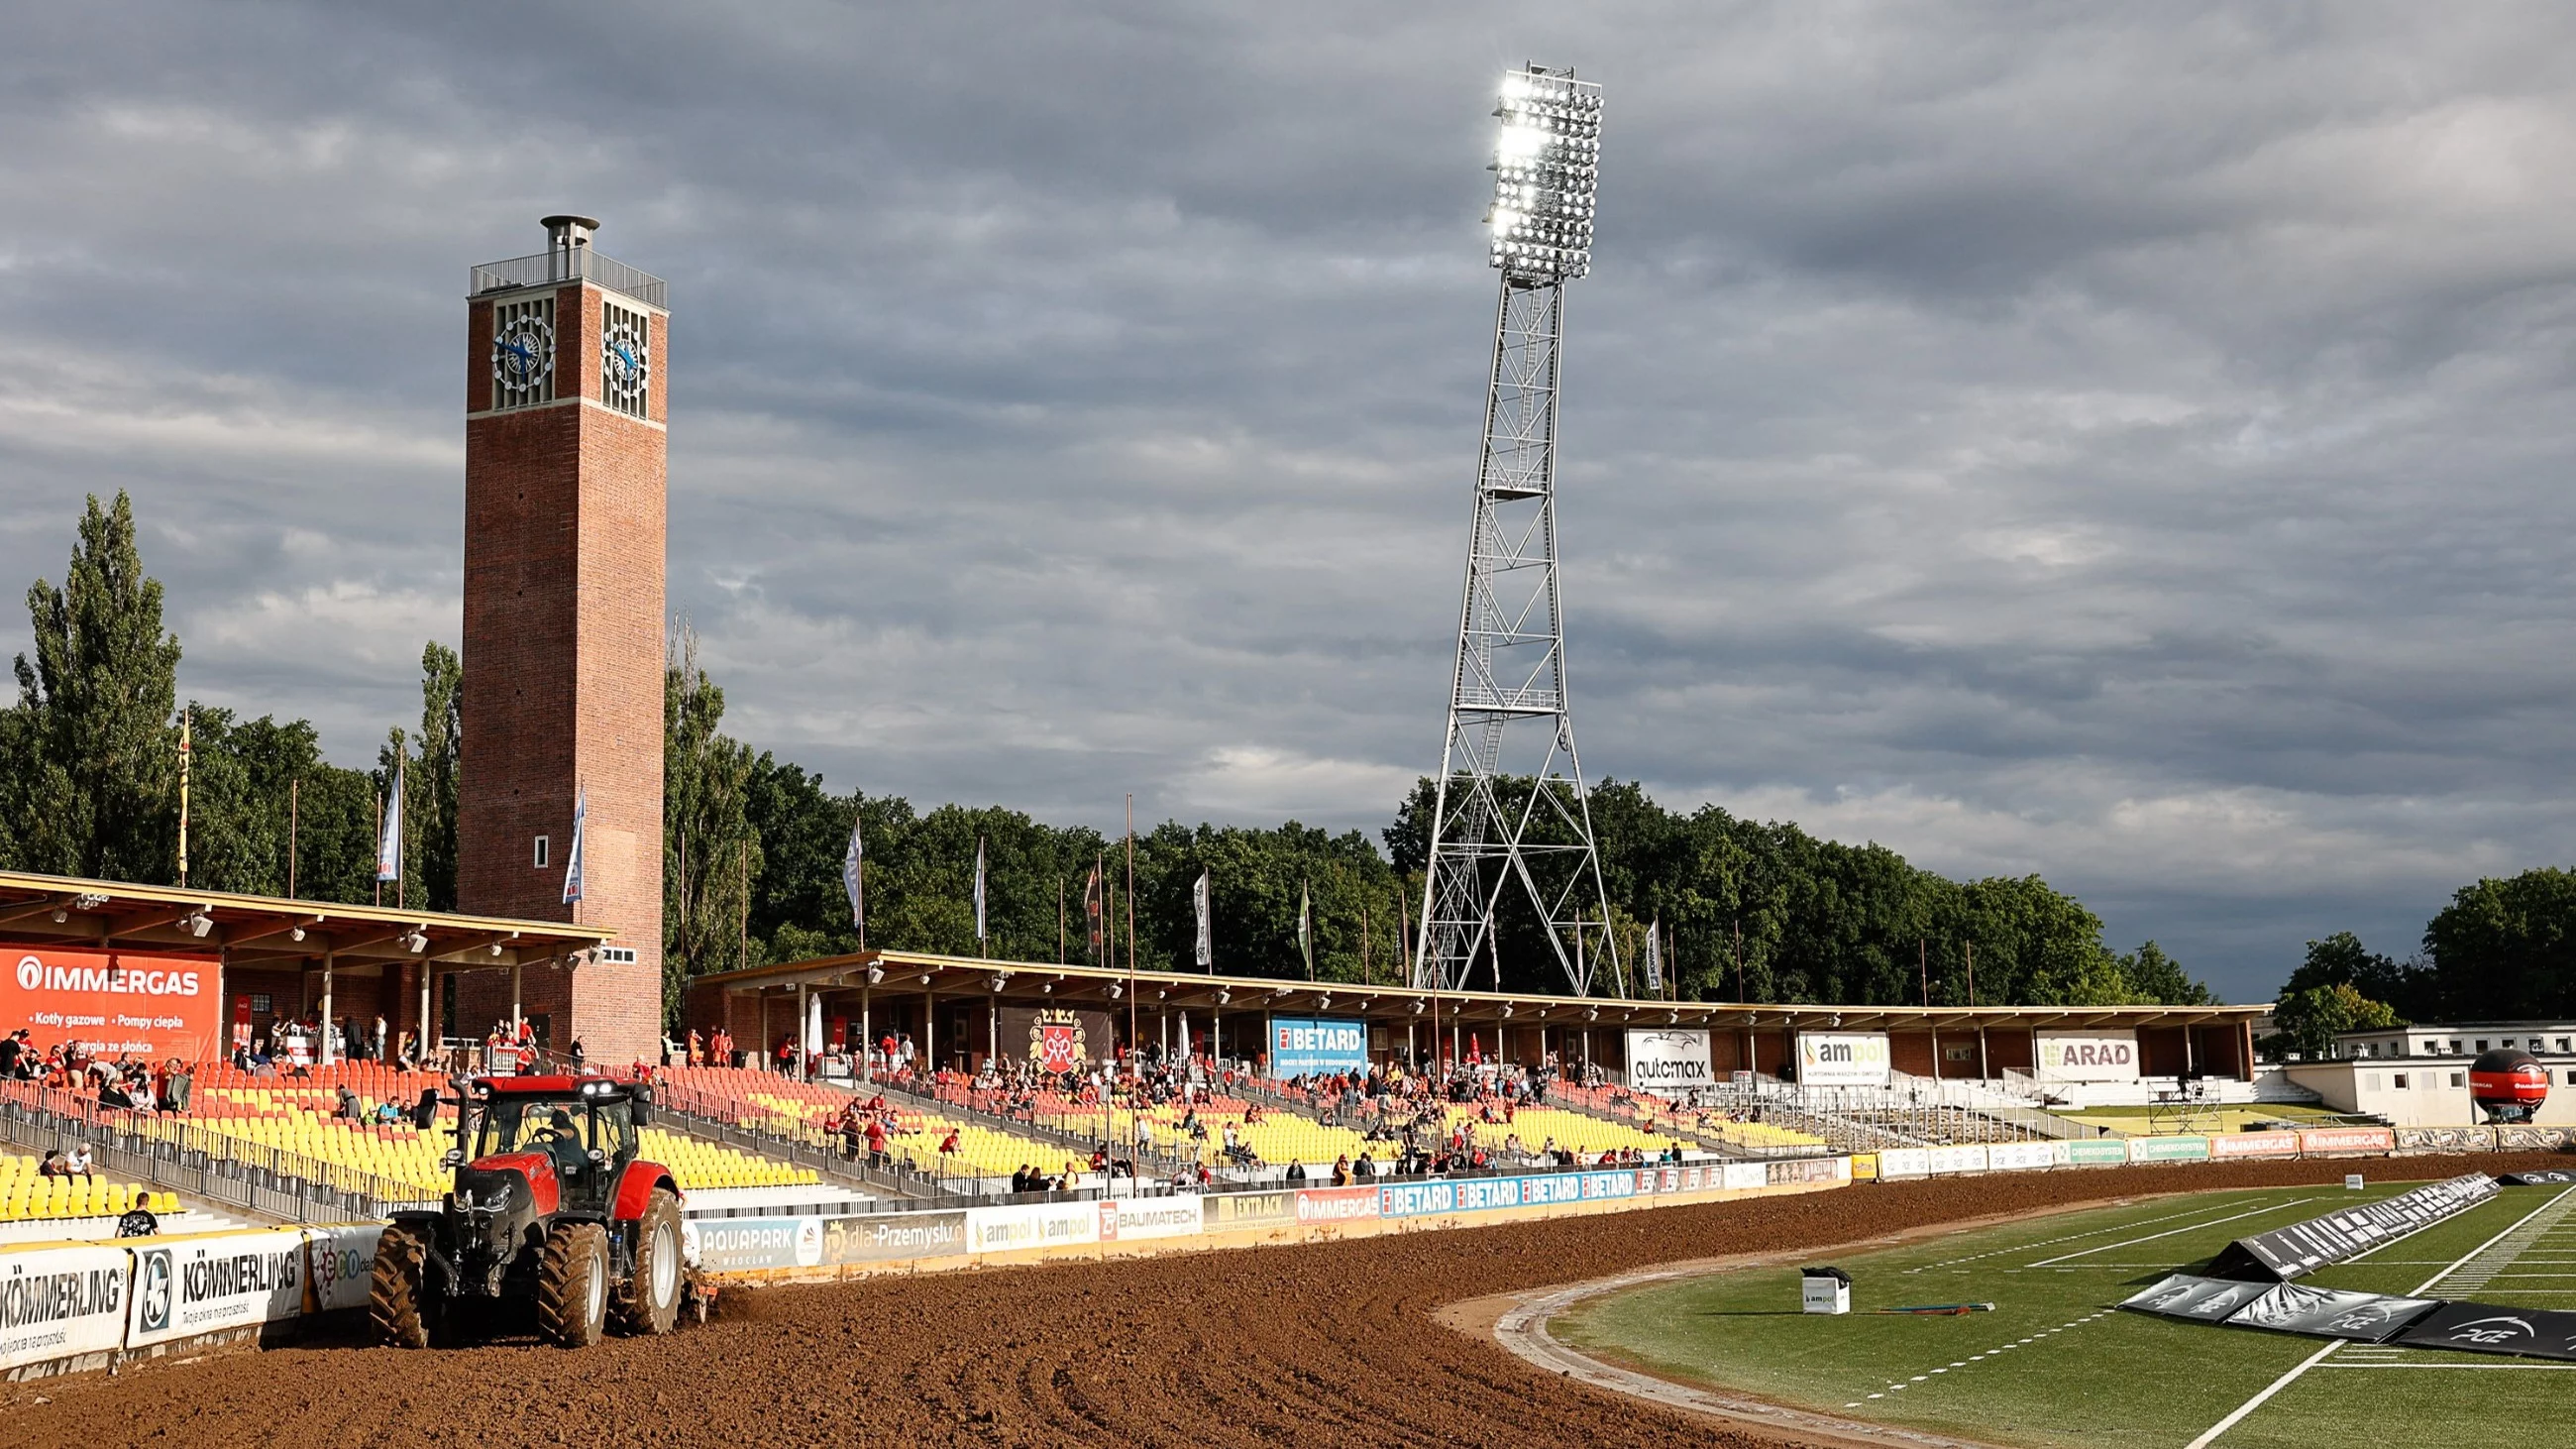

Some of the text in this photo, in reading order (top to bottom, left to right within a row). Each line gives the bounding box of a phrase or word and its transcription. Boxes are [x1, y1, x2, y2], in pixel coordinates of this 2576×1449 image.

[44, 965, 199, 996] IMMERGAS
[35, 1012, 63, 1027] Kotły
[65, 1016, 105, 1027] gazowe
[117, 1014, 153, 1030] Pompy
[107, 1043, 120, 1053] ze
[1293, 1027, 1360, 1051] BETARD
[1819, 1040, 1884, 1068] ampol
[2063, 1044, 2131, 1066] ARAD
[1636, 1057, 1706, 1079] automax
[2228, 1135, 2295, 1153] IMMERGAS
[2316, 1133, 2387, 1148] IMMERGAS
[1466, 1180, 1519, 1208] BETARD
[1531, 1175, 1579, 1202] BETARD
[1590, 1171, 1634, 1198] BETARD
[1238, 1194, 1283, 1218] ENTRACK
[1309, 1196, 1380, 1220] IMMERGAS
[1394, 1185, 1452, 1214] BETARD
[986, 1216, 1032, 1244] ampol
[1047, 1212, 1091, 1241] ampol
[1119, 1208, 1197, 1229] BAUMATECH
[703, 1228, 794, 1252] AQUAPARK
[1810, 1294, 1834, 1304] ampol
[2449, 1328, 2519, 1344] PGE
